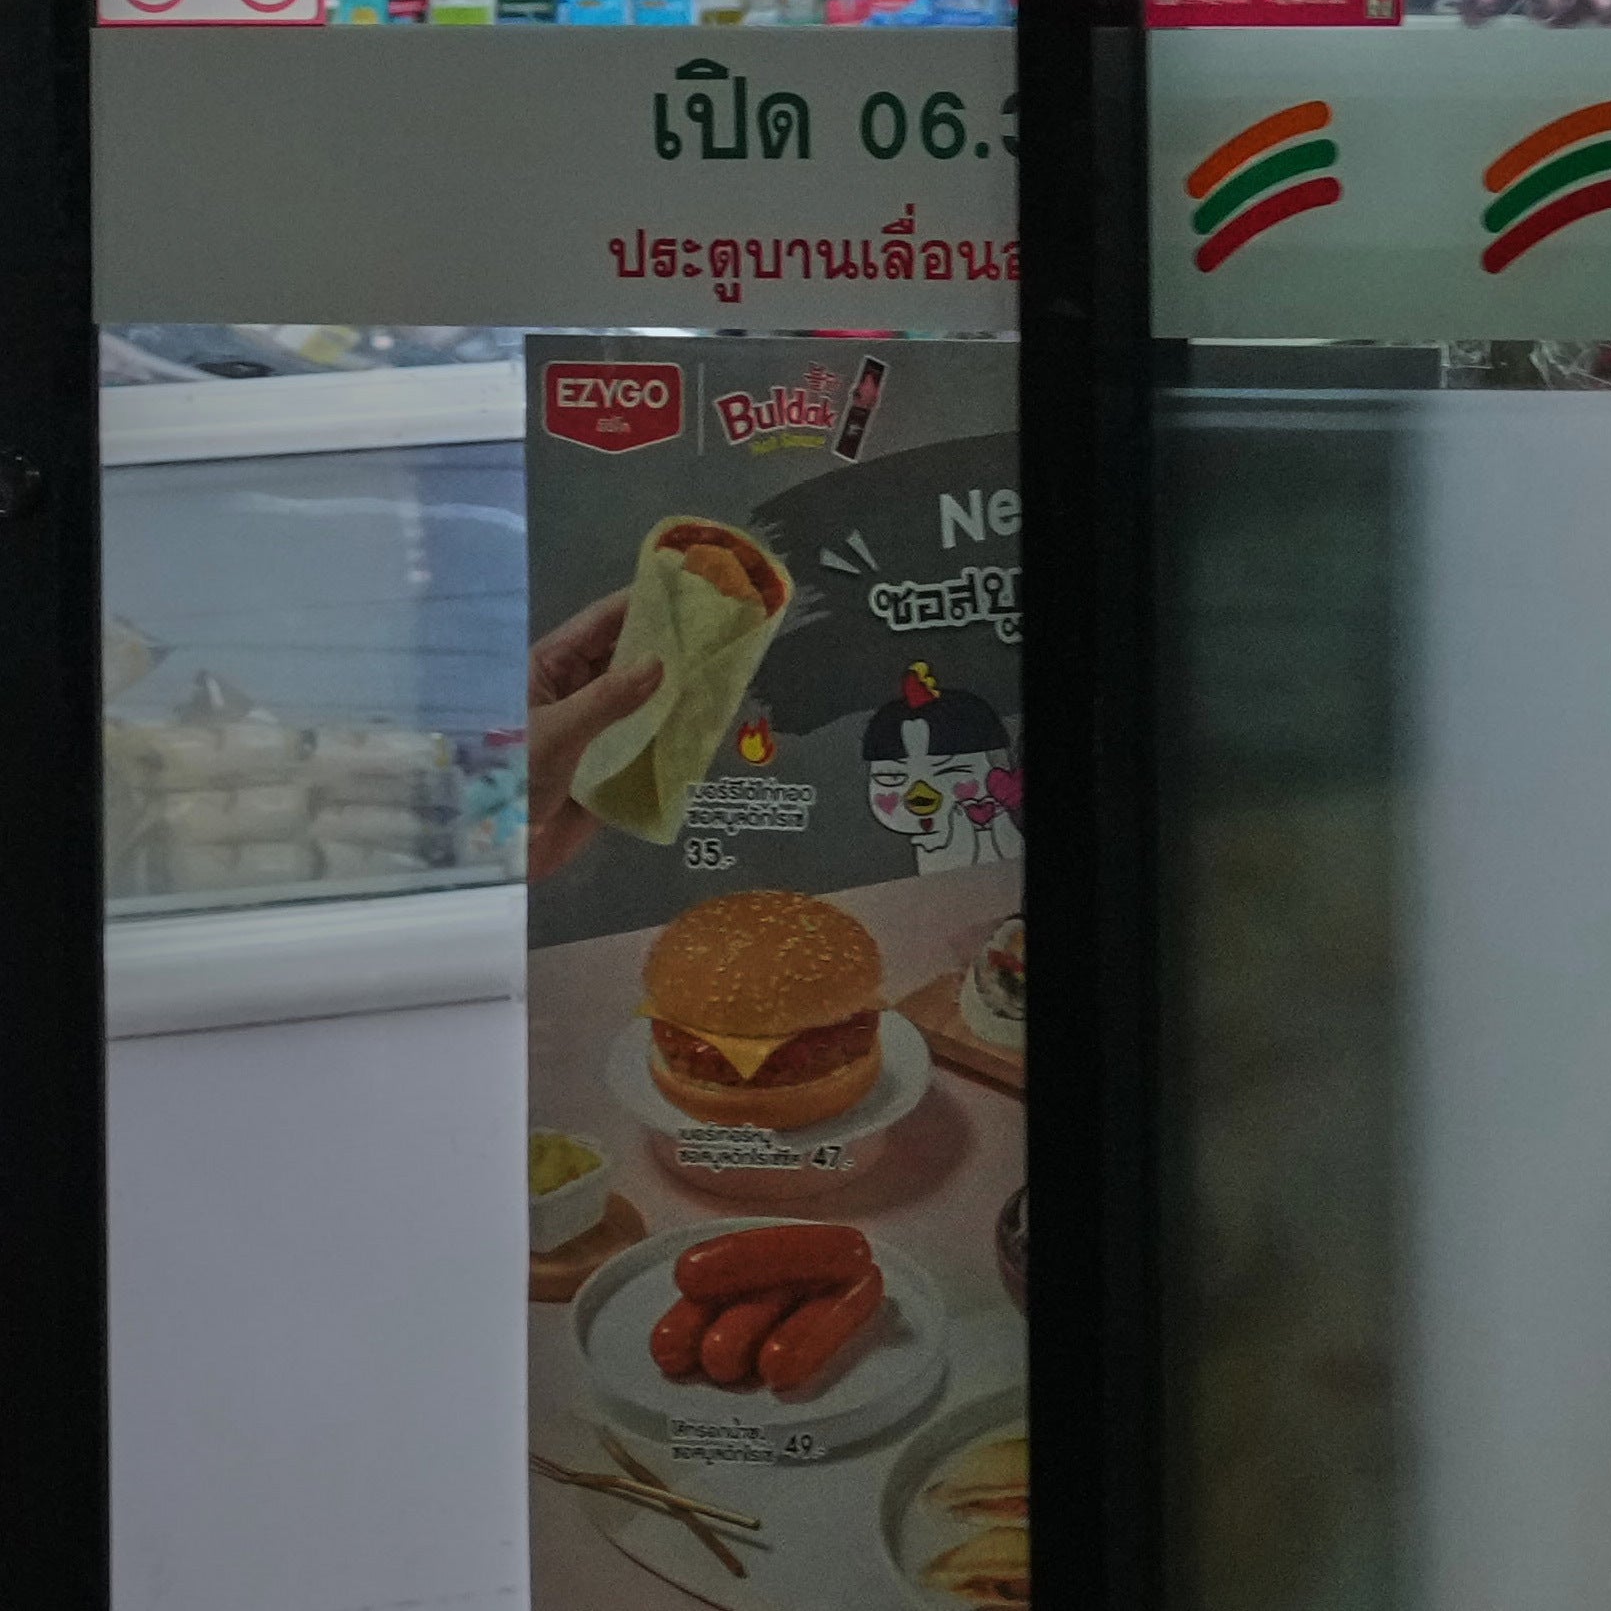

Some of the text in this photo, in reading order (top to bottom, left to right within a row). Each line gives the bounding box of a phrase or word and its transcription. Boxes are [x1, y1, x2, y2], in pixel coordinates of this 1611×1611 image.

[652, 57, 812, 162] เปิด
[556, 377, 669, 410] EZYGO
[715, 388, 838, 444] Buldak
[939, 489, 1023, 550] Ne
